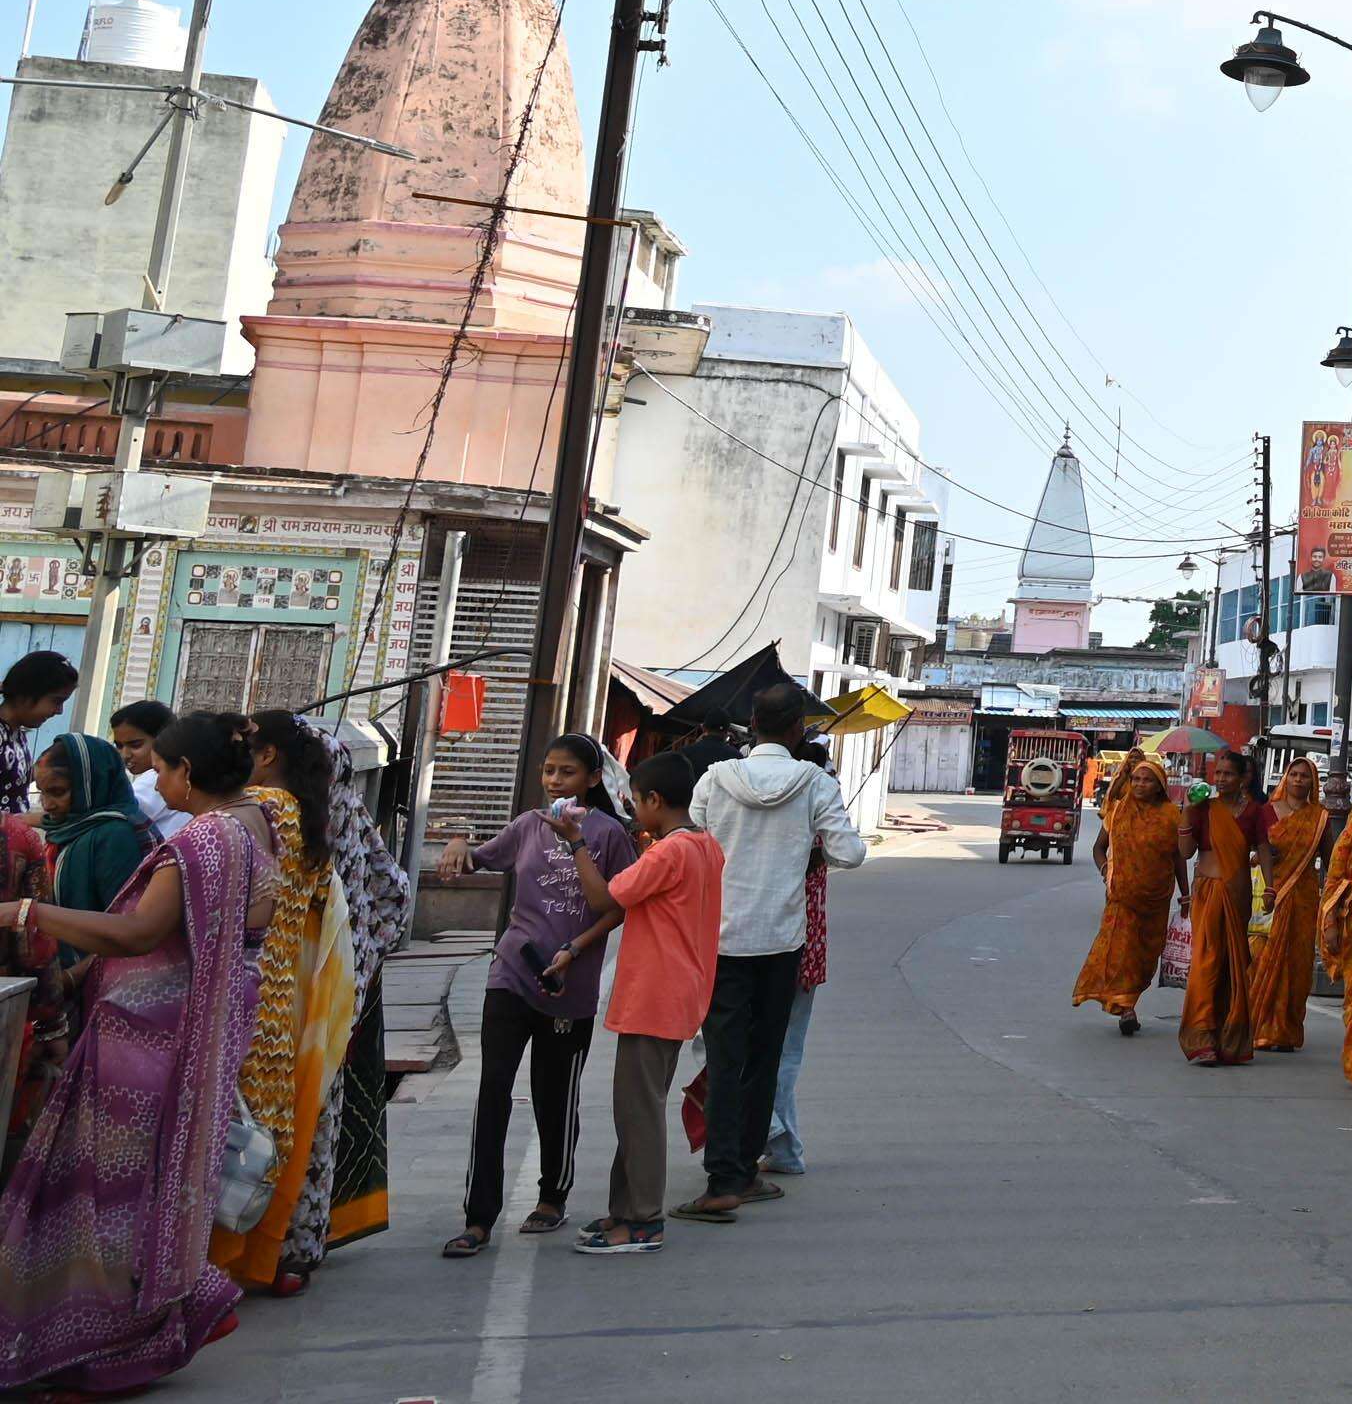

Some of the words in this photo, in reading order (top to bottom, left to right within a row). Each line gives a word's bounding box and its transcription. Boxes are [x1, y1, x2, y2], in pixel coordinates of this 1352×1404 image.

[218, 517, 238, 529] राम
[262, 517, 276, 532] श्री
[281, 520, 299, 532] राम
[301, 522, 321, 533] जय
[322, 522, 341, 534] राम
[342, 523, 361, 535] जय
[363, 524, 382, 535] जय
[400, 562, 415, 577] श्री
[397, 582, 416, 594] राम
[394, 601, 413, 613] जय
[392, 620, 411, 632] राम
[389, 638, 408, 650] जय
[386, 657, 406, 669] जय
